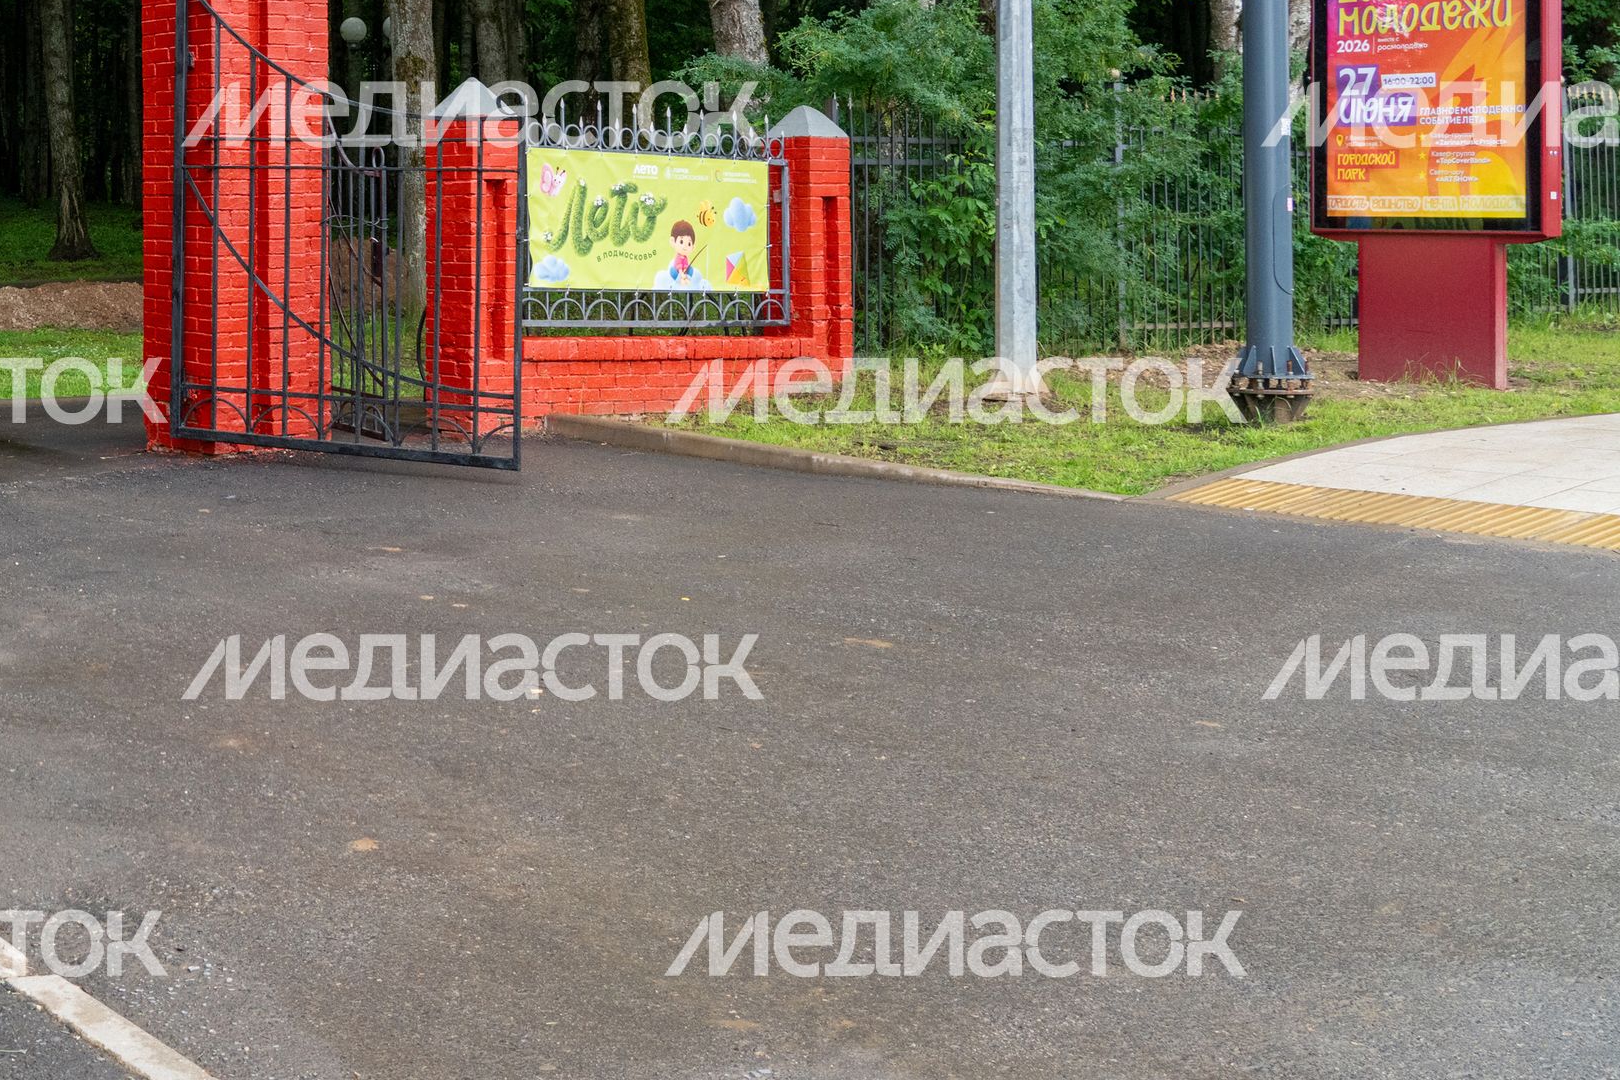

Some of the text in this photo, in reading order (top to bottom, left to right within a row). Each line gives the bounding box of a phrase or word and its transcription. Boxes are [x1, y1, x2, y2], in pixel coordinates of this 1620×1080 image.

[1336, 40, 1370, 53] 2026
[1339, 67, 1378, 96] 27
[1337, 151, 1396, 166] ГОРОДСКОЙ
[1337, 168, 1366, 180] ПАРК
